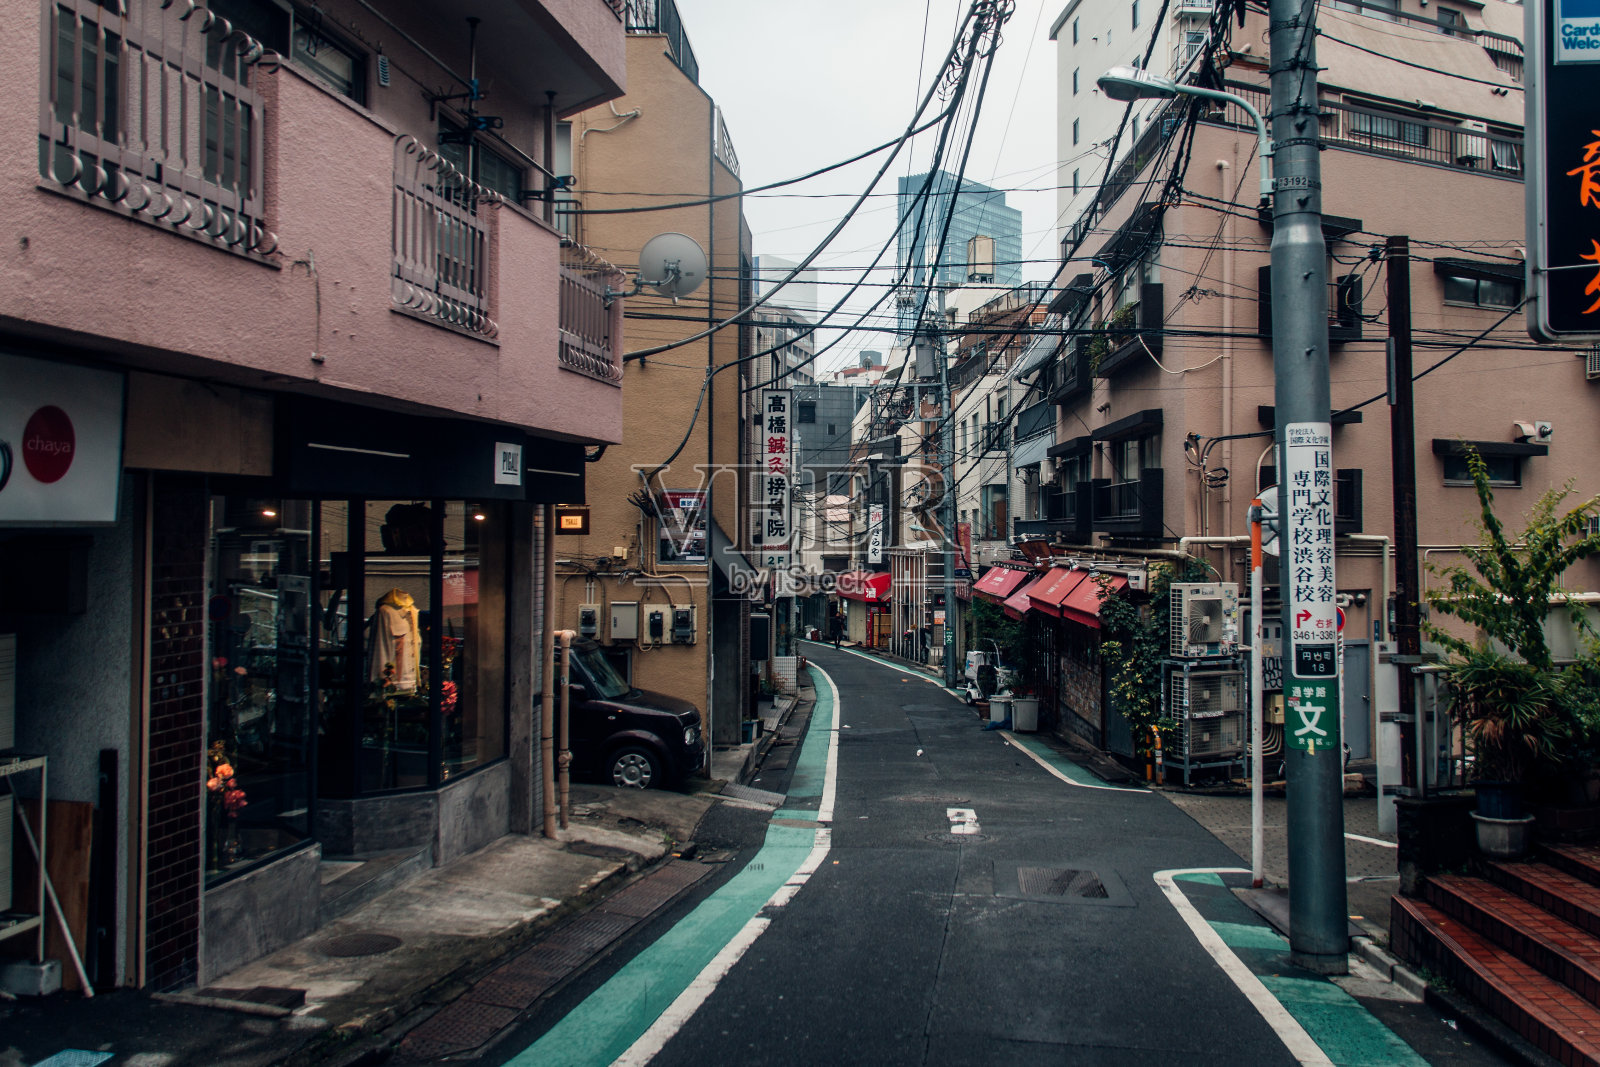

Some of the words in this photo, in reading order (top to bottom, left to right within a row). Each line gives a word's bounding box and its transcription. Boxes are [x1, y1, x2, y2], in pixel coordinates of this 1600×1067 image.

[1283, 176, 1307, 186] 3-192
[27, 434, 71, 456] chaya
[1314, 450, 1333, 602] 国際文化理容美容
[1291, 470, 1314, 602] 専門学校渋谷校
[1315, 619, 1333, 628] 右折
[1293, 631, 1336, 640] 3461-3361
[1312, 663, 1325, 672] 18
[1292, 686, 1326, 698] 通学路
[1294, 701, 1327, 736] 文
[1299, 737, 1323, 746] 渋区
